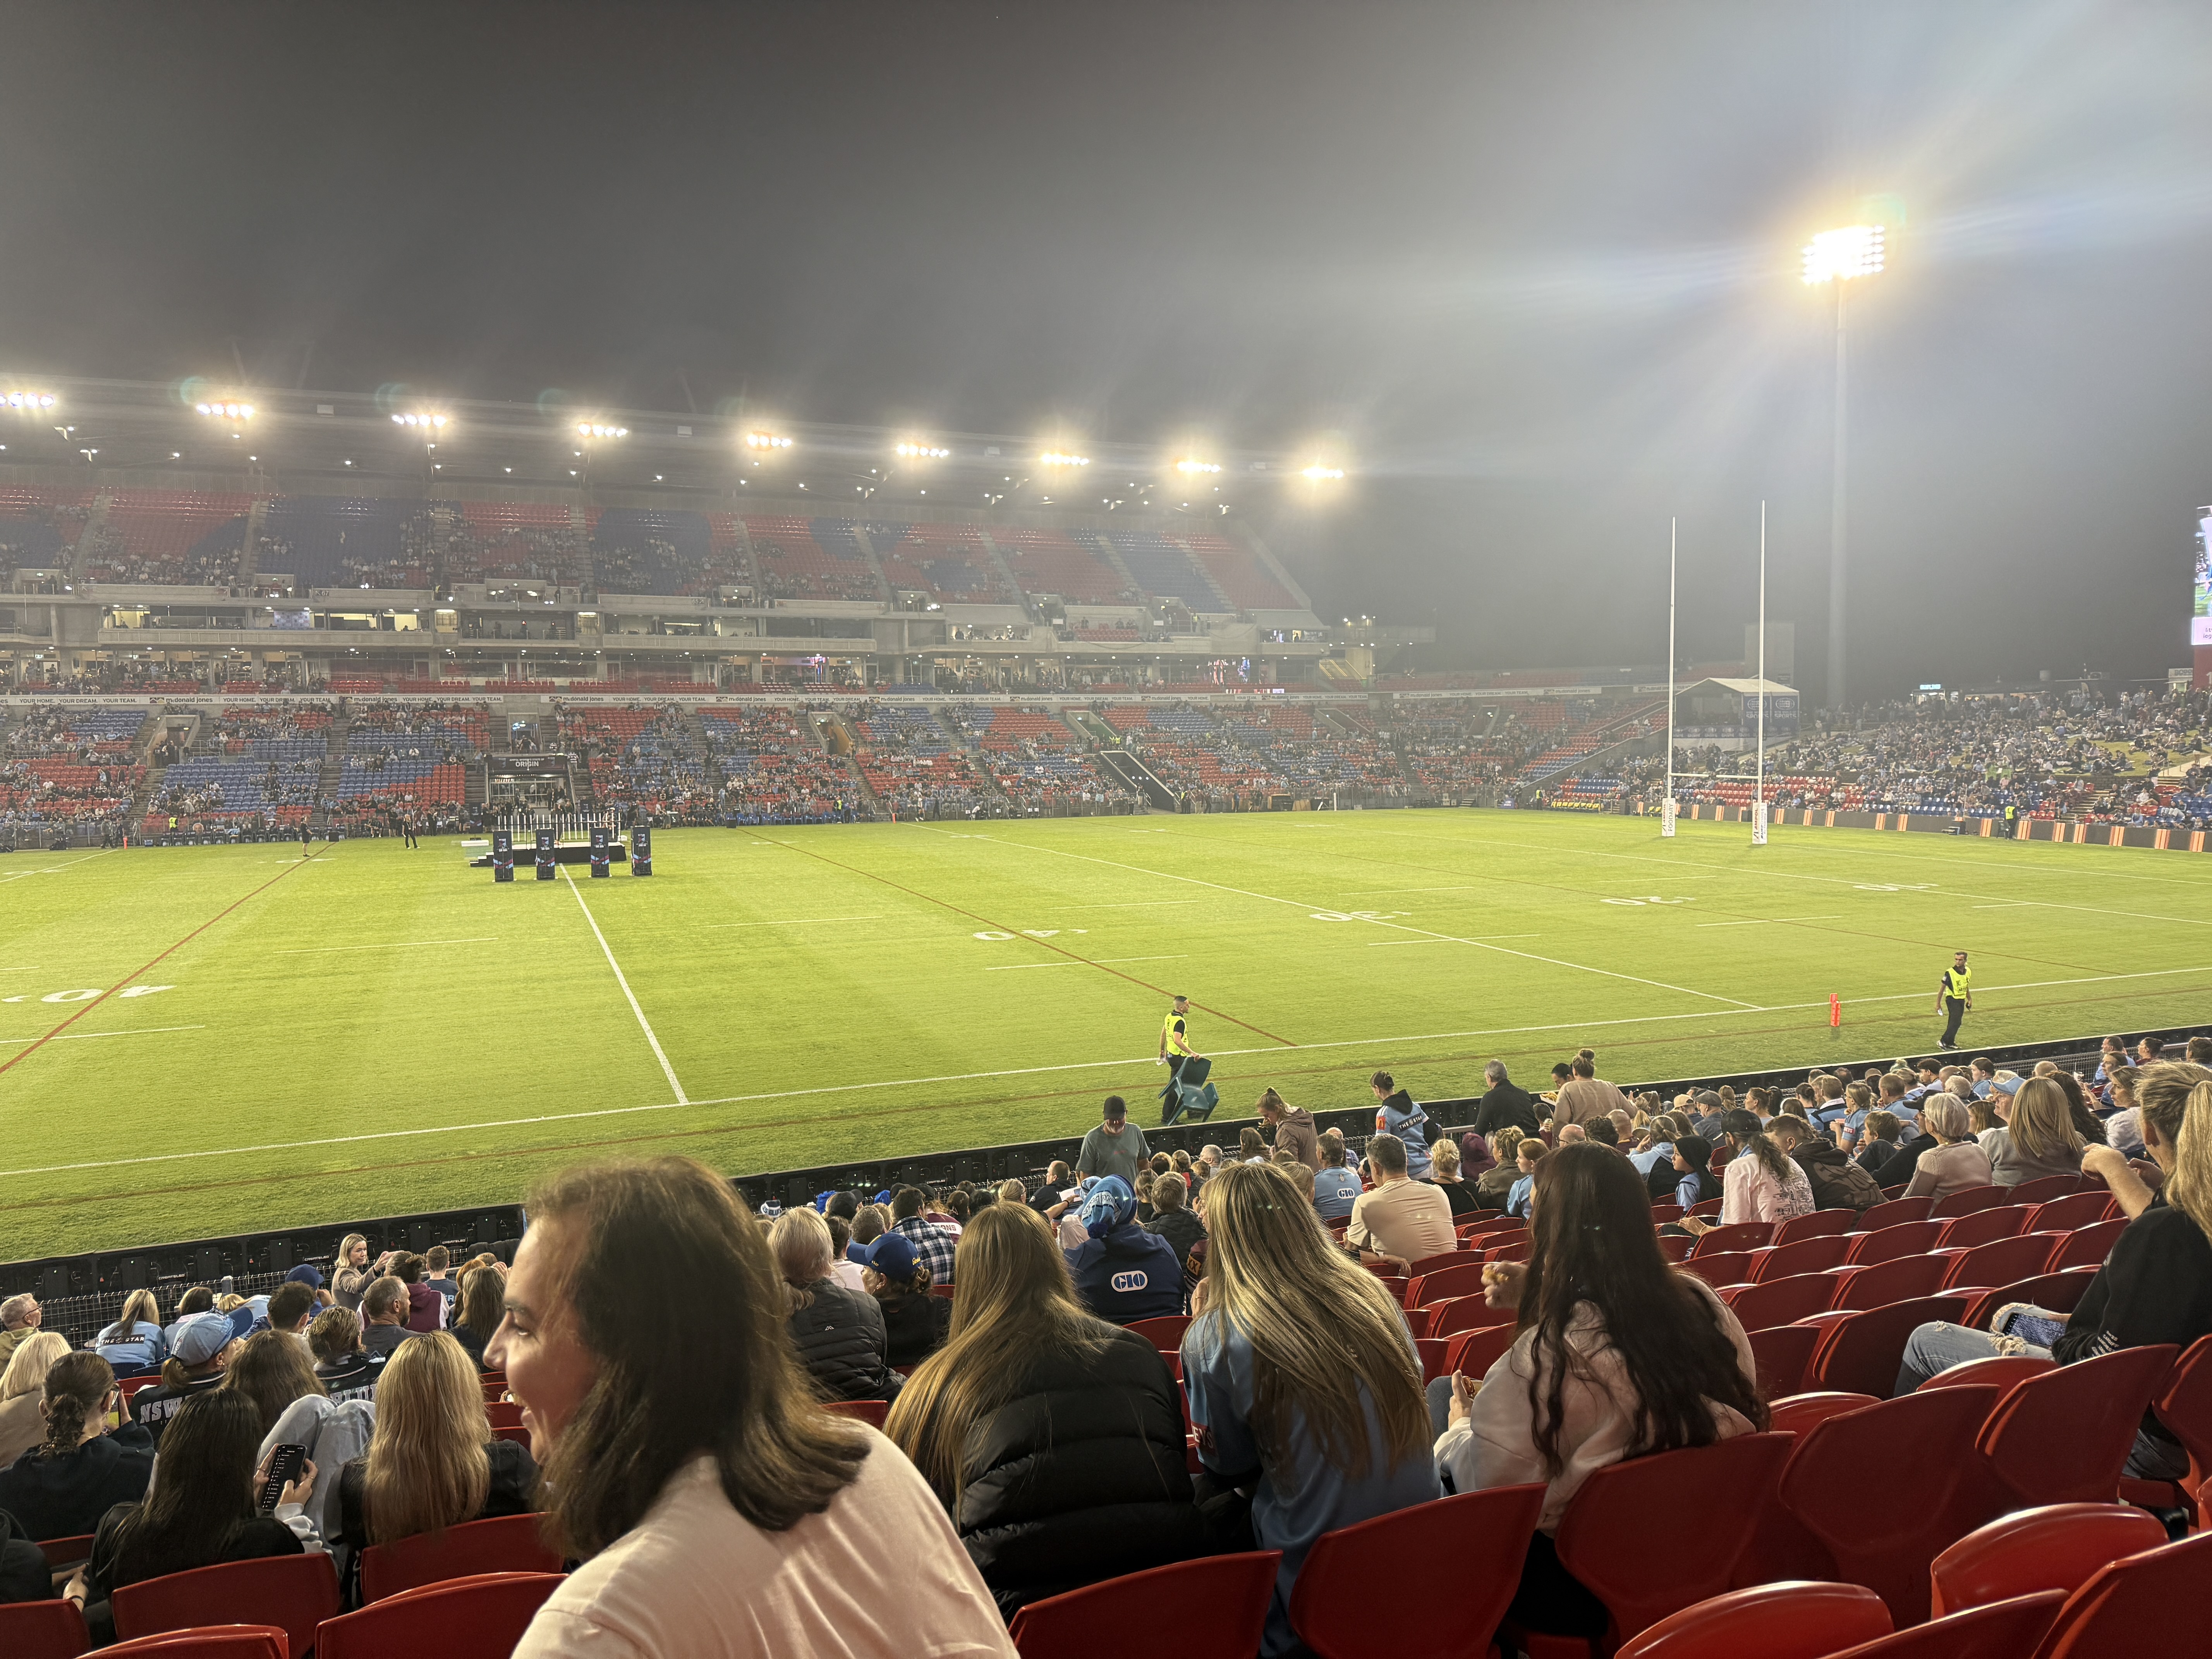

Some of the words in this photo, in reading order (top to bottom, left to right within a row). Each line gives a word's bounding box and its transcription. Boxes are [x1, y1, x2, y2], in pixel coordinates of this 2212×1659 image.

[1339, 1189, 1353, 1197] GIO
[1114, 1273, 1145, 1289] GIO
[140, 1397, 182, 1424] NSW
